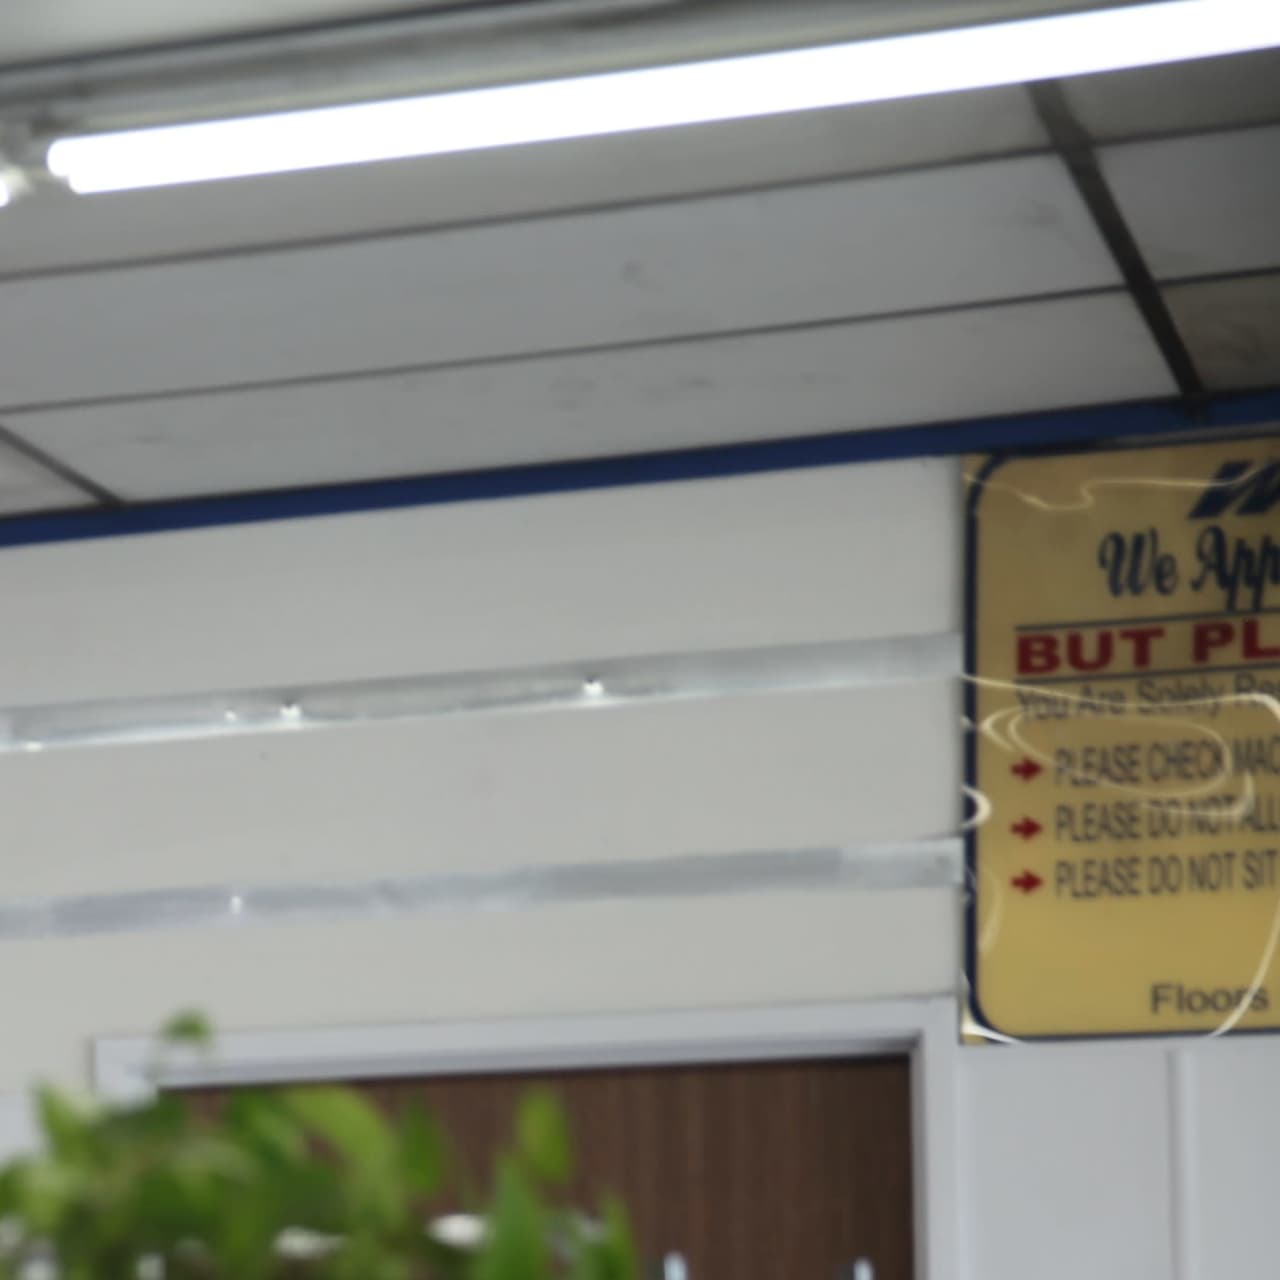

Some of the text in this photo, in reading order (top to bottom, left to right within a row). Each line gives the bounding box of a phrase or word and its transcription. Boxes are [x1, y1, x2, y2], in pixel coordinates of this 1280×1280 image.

[1097, 525, 1178, 597] We
[1016, 616, 1280, 676] BUT PL
[1054, 744, 1142, 787] PLEASE
[1147, 739, 1231, 782] CHECK
[1054, 800, 1142, 843] PLEASE
[1147, 798, 1184, 838] DO
[1188, 794, 1239, 836] NOT
[1054, 848, 1279, 898] PLEASE DO NOT SIT
[1149, 981, 1269, 1015] Floors
